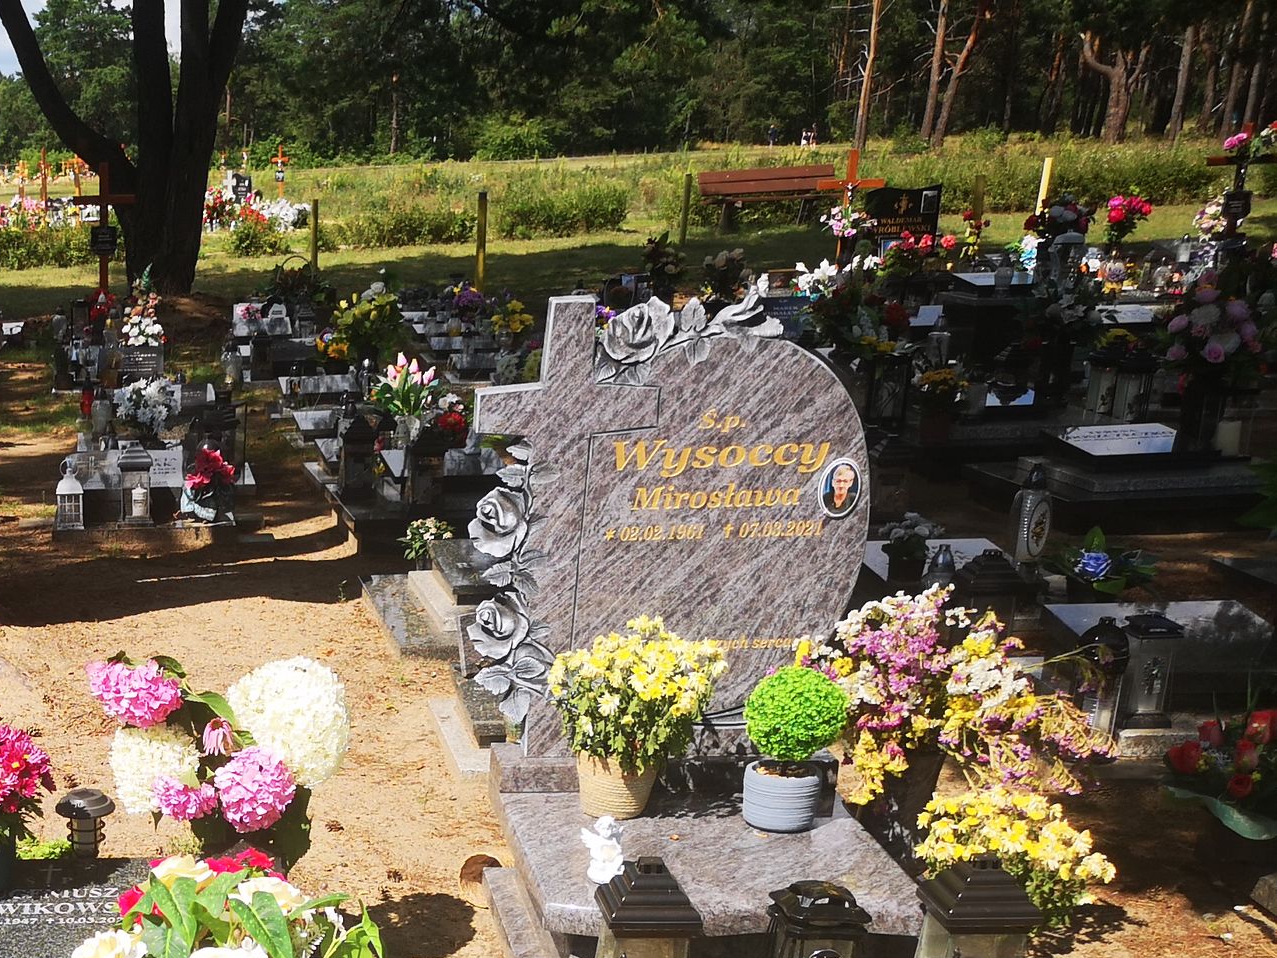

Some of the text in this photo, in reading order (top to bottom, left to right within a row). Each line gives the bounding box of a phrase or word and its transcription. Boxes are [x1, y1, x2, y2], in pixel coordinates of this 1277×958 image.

[699, 407, 746, 433] Ś.p.
[613, 439, 831, 478] Wysoccy
[631, 481, 801, 511] Mirosława
[619, 524, 706, 542] 02.02.1961
